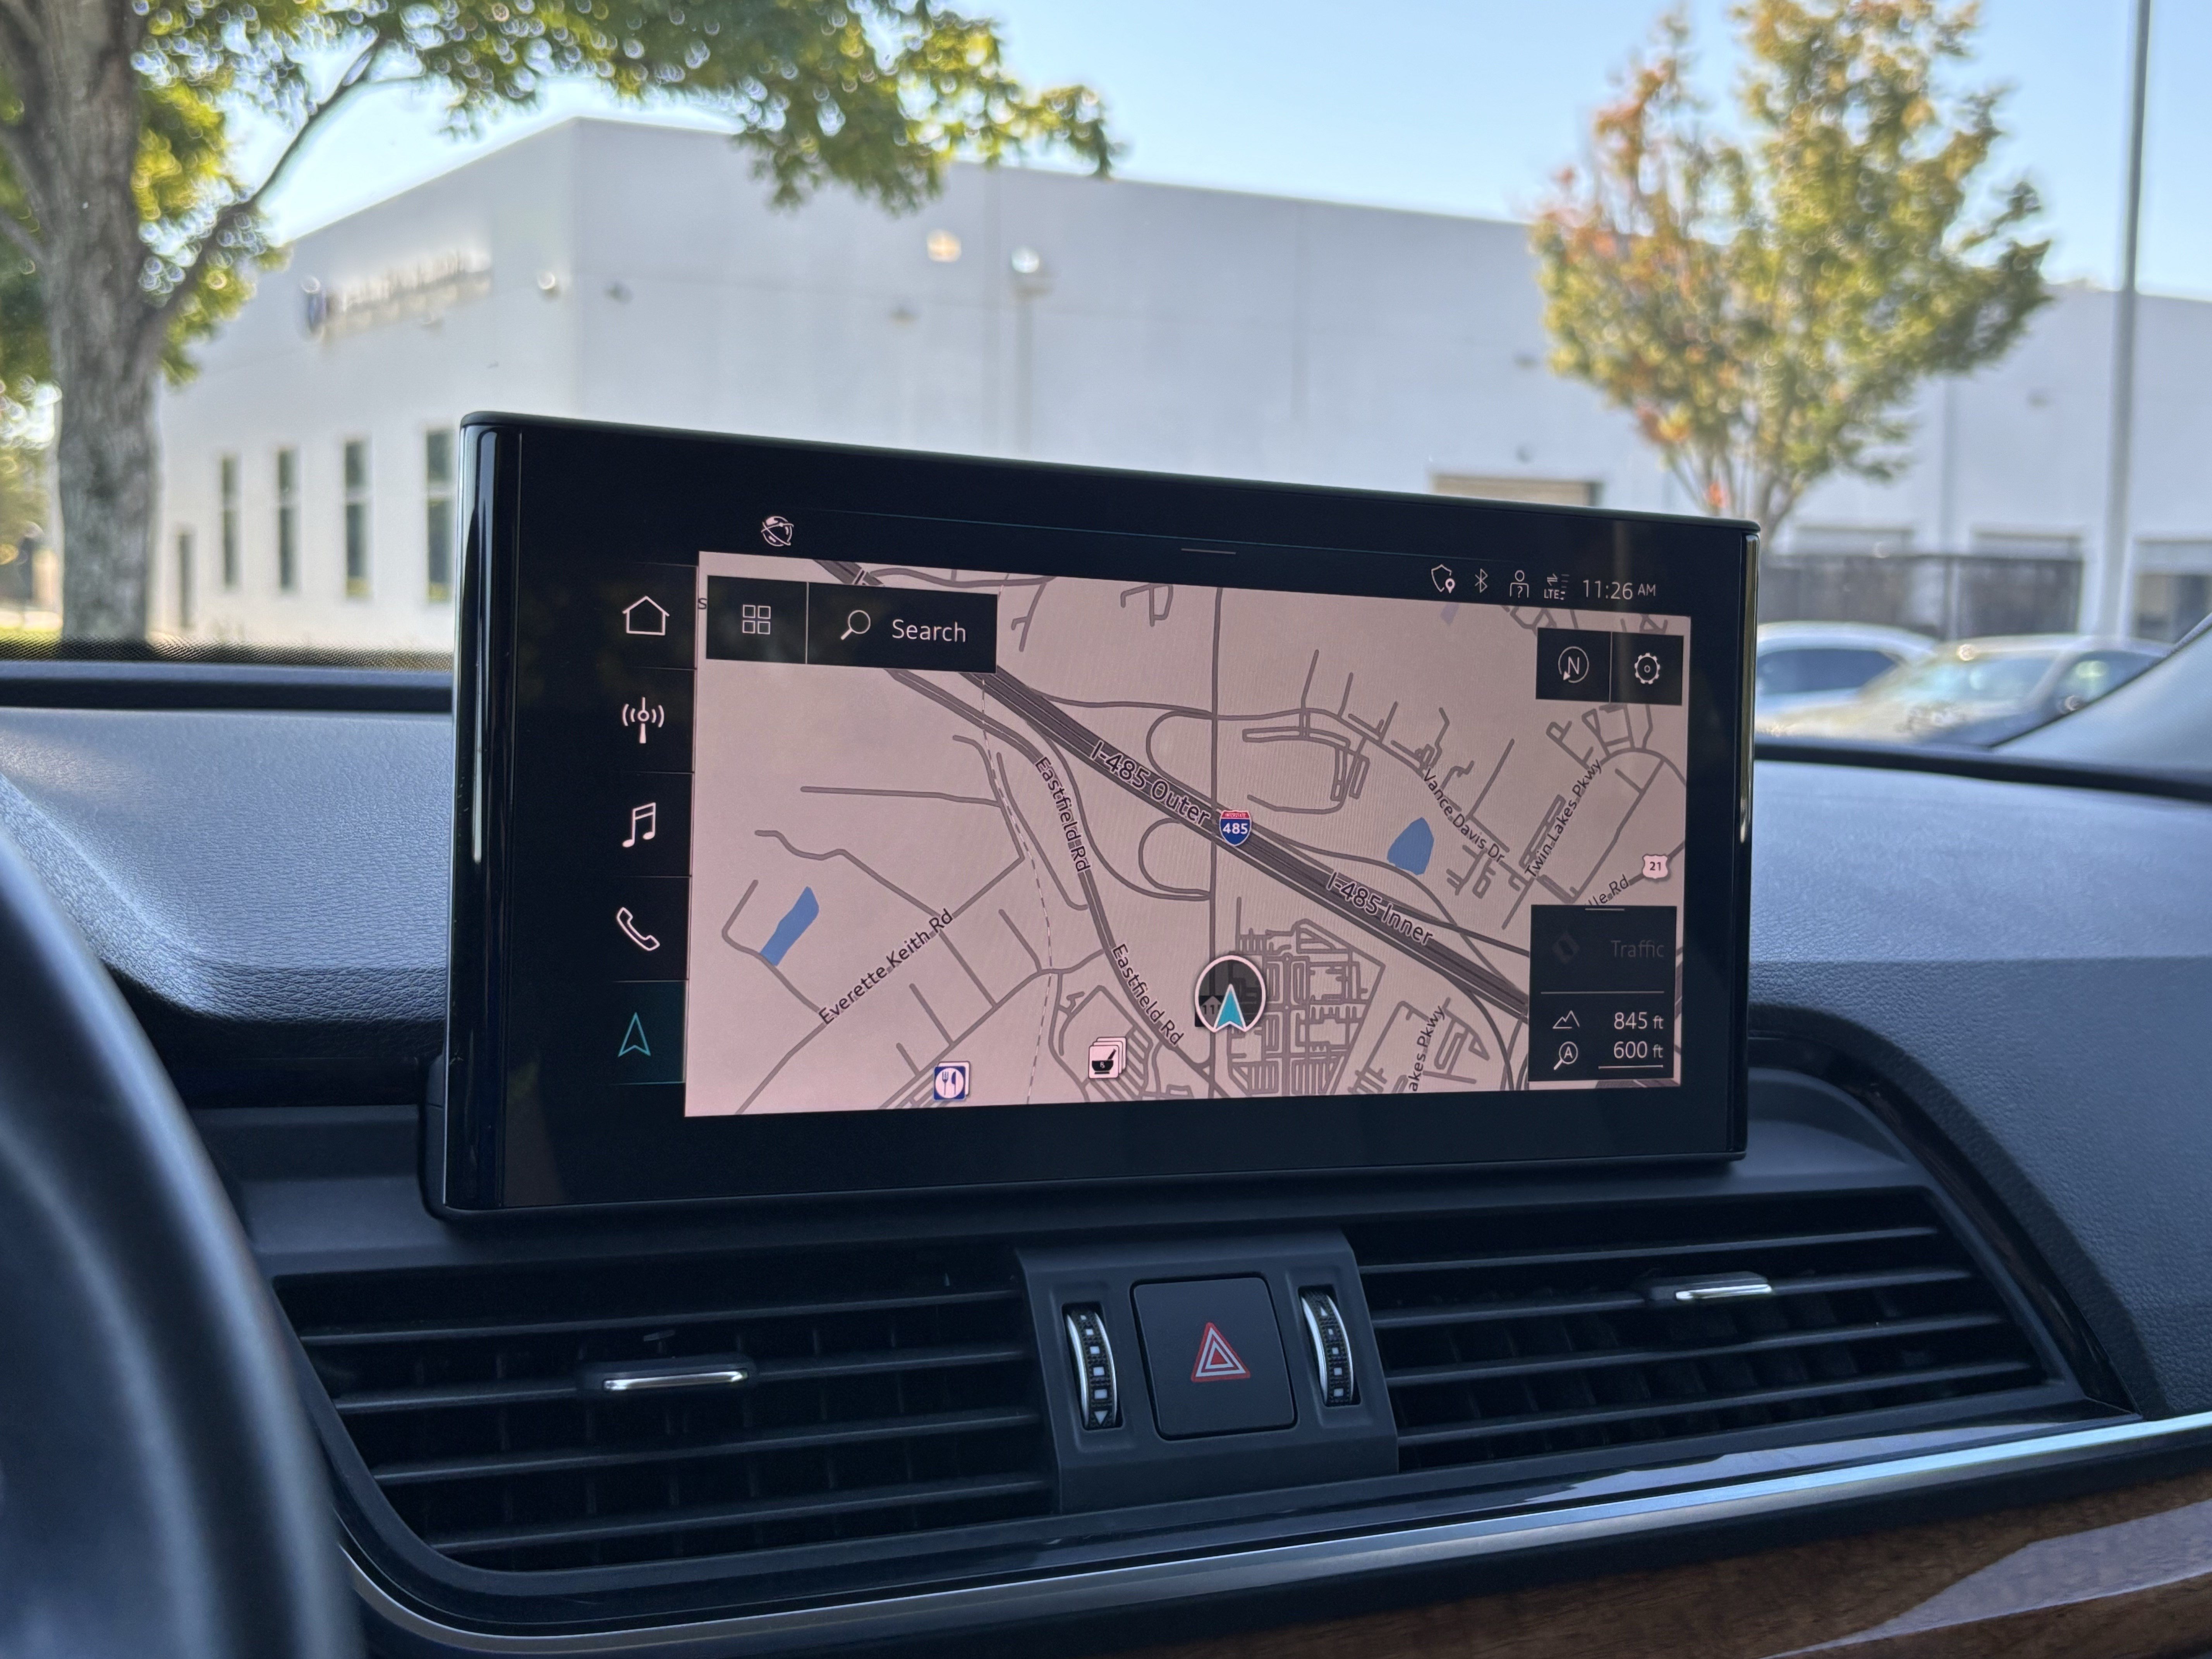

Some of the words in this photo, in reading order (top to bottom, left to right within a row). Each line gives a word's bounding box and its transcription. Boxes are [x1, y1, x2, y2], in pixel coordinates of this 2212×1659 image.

[1544, 589, 1559, 599] LTE
[1583, 579, 1633, 600] 11:26
[1637, 583, 1656, 597] AM
[892, 619, 966, 642] Search
[1567, 656, 1580, 675] N
[1091, 741, 1150, 788] I-485
[1152, 780, 1210, 825] Outer
[1035, 756, 1082, 842] Eastfield
[1070, 845, 1091, 872] Rd
[1424, 768, 1453, 817] Vance
[1453, 813, 1487, 850] Davis
[1487, 843, 1505, 862] Dr
[1524, 843, 1553, 877] Twin
[1547, 799, 1577, 842] Lakes
[1571, 759, 1602, 798] Pkwy
[1222, 822, 1249, 835] 485
[1650, 861, 1661, 871] 21
[1609, 873, 1629, 896] Rd
[1327, 871, 1382, 914] I-485
[1382, 904, 1433, 945] Inner
[1610, 939, 1665, 958] Traffic
[818, 967, 888, 1025] Everette
[886, 931, 931, 969] Keith
[928, 908, 954, 933] Rd
[1112, 943, 1165, 1023] Eastfield
[1160, 1019, 1185, 1045] Rd
[1417, 1005, 1445, 1048] Pkwy
[1614, 1012, 1647, 1030] 845
[1652, 1015, 1664, 1029] ft
[1613, 1041, 1648, 1059] 600
[1652, 1044, 1664, 1058] ft
